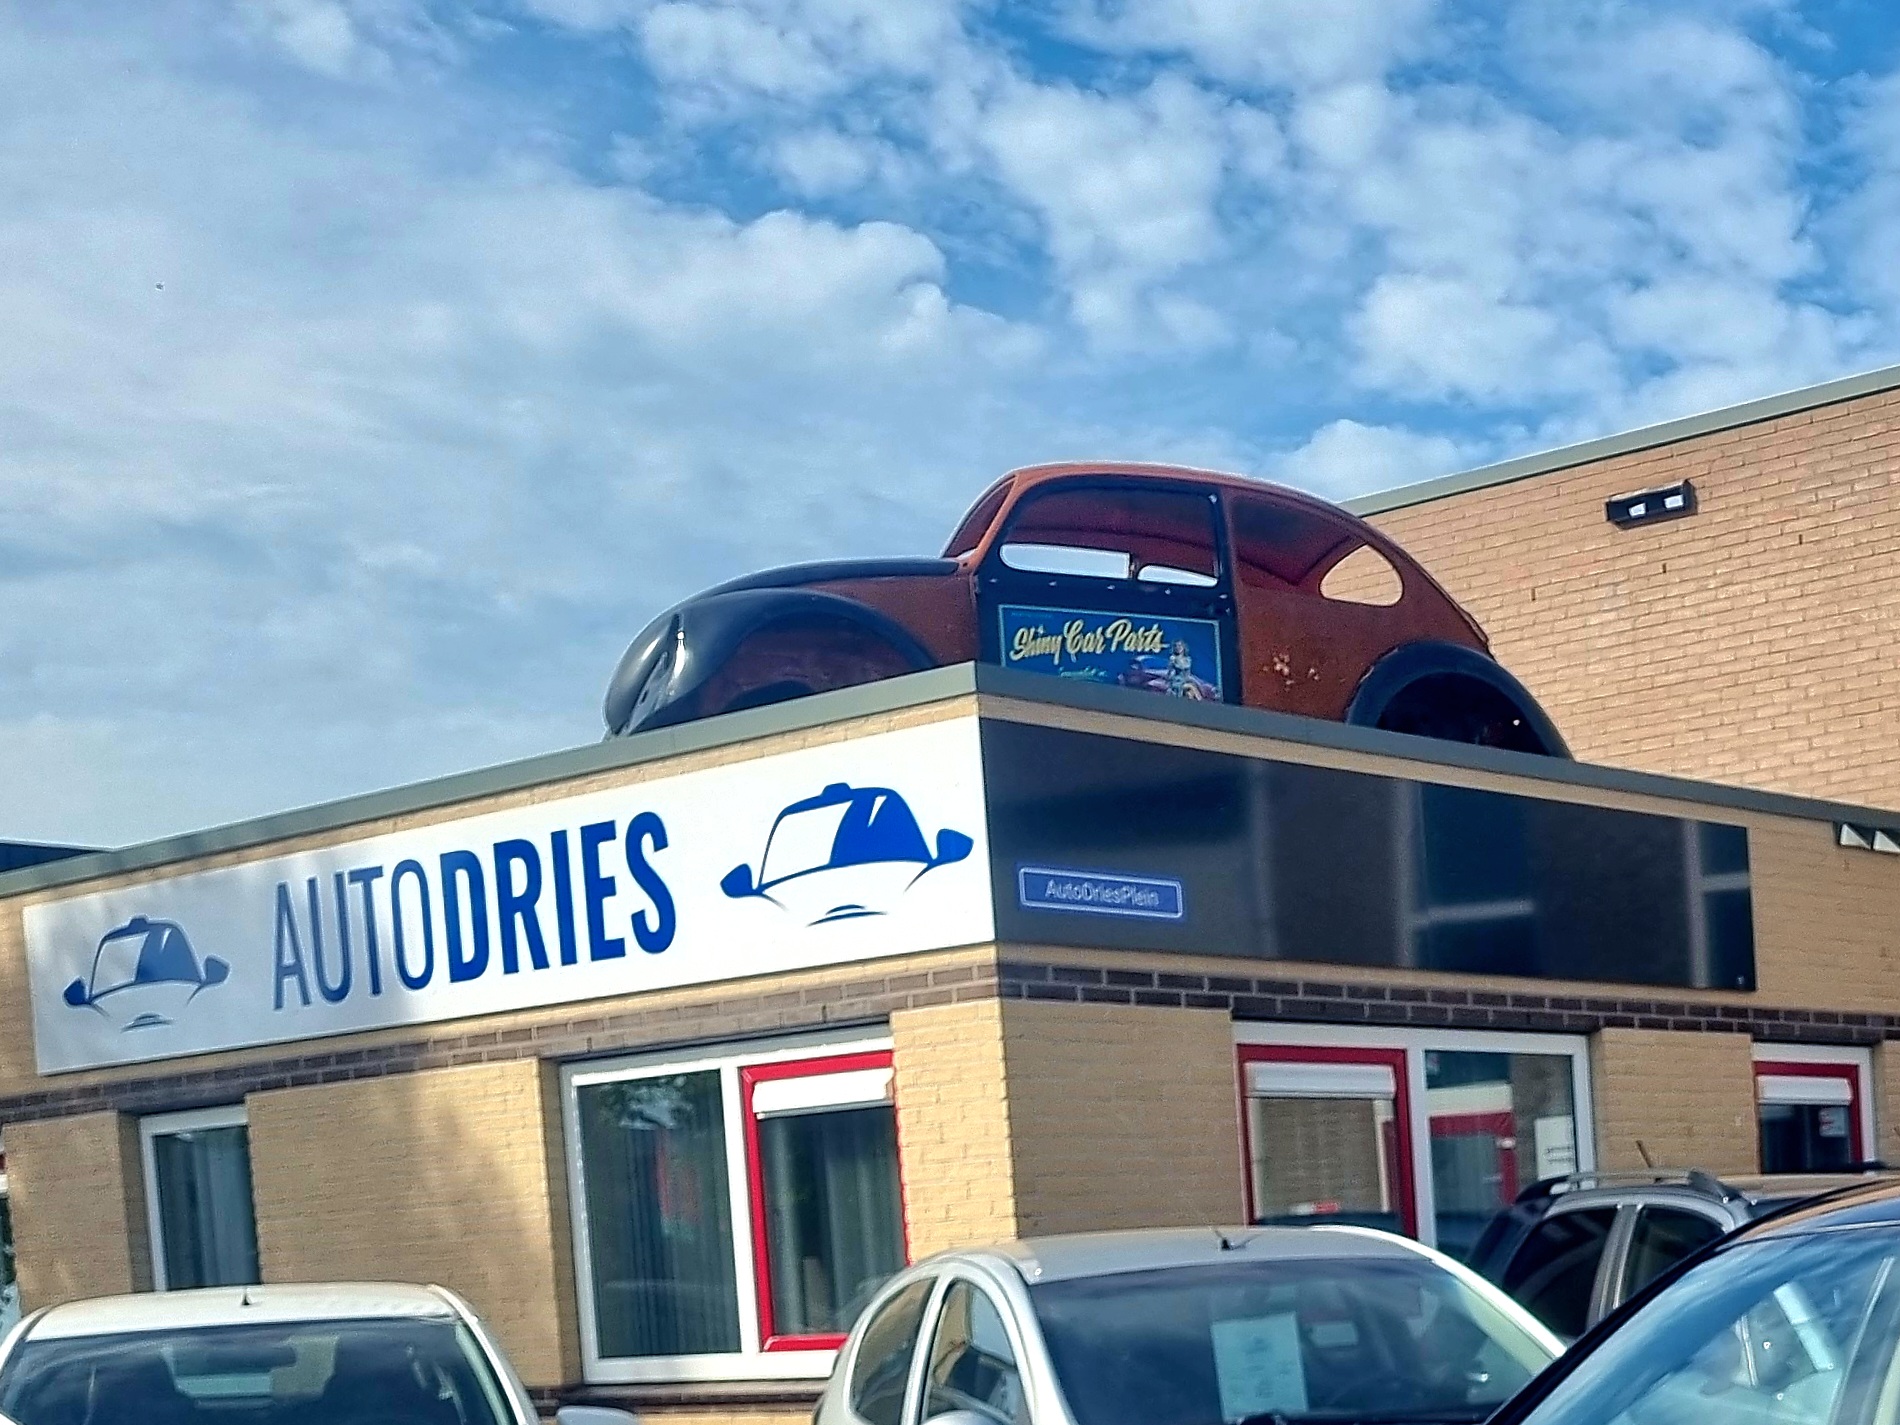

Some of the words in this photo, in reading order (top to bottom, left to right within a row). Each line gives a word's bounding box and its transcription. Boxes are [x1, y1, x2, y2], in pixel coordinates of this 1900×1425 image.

[1009, 624, 1063, 666] Shiny
[1063, 618, 1107, 659] Car
[1105, 618, 1170, 653] Parts
[272, 810, 677, 1012] AUTODRIES
[1044, 878, 1160, 907] AutoDriesPlein
